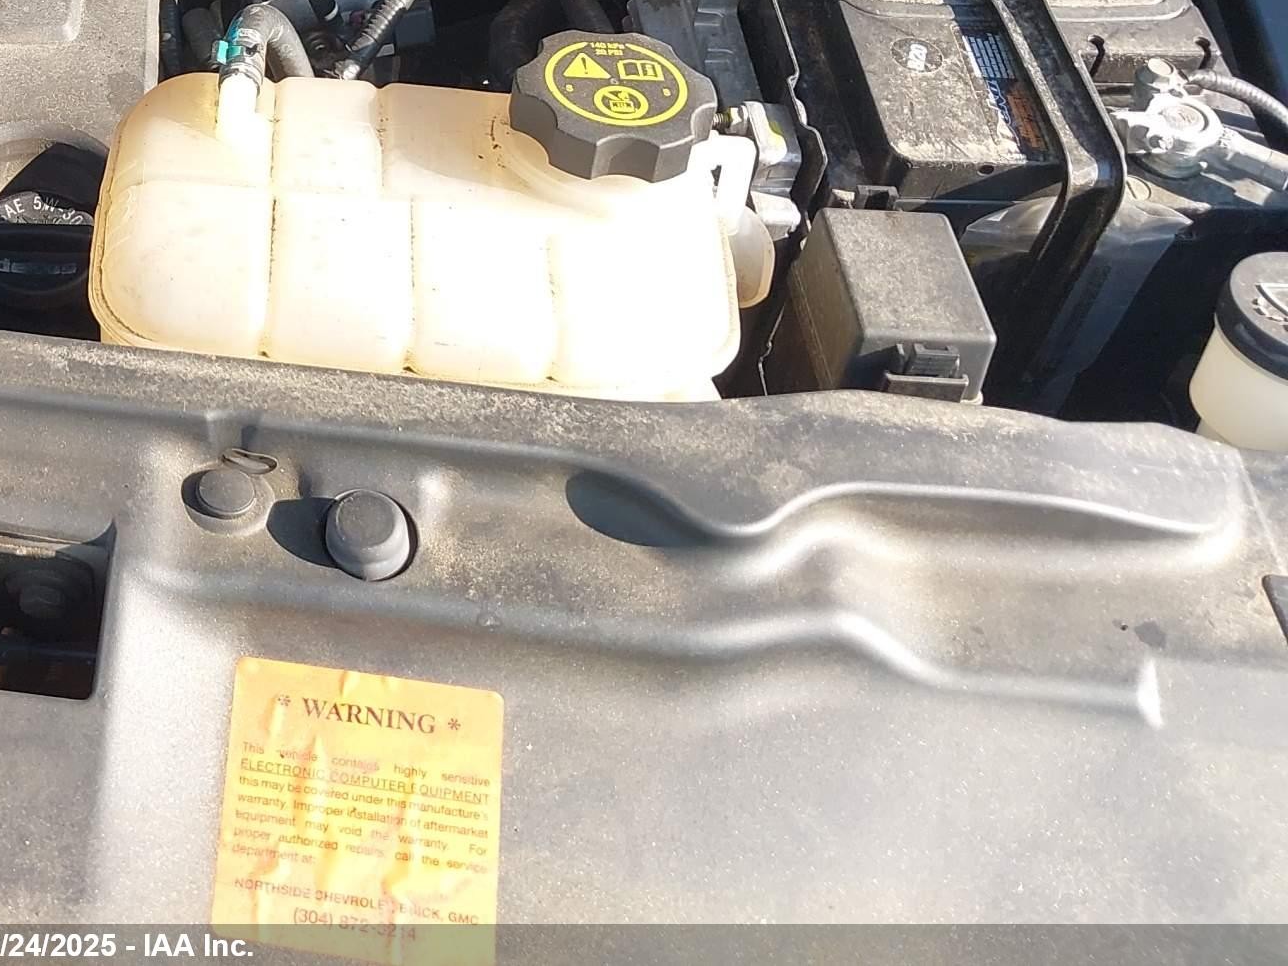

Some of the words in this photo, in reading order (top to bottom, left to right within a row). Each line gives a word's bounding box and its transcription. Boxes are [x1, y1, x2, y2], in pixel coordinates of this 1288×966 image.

[302, 697, 436, 734] WARNING
[240, 757, 325, 779] ELECTRONIC
[329, 769, 405, 791] COMPUTER
[408, 781, 489, 803] EQUIPMENT
[242, 740, 265, 754] This
[394, 763, 427, 779] highly
[441, 772, 491, 787] sensitive
[239, 775, 258, 787] this
[261, 779, 285, 793] may
[287, 780, 302, 793] be
[303, 785, 349, 800] covered
[352, 792, 383, 805] under
[386, 797, 407, 809] this
[233, 826, 272, 841] proper
[278, 834, 338, 851] authorized
[421, 855, 440, 866] the
[305, 819, 330, 833] may
[338, 824, 363, 837] void
[370, 828, 389, 841] the
[468, 843, 488, 856] For
[409, 819, 421, 828] of
[423, 820, 489, 839] aftermarket
[231, 842, 299, 860] department
[234, 878, 312, 899] NORTHSIDE
[447, 911, 480, 926] GMC
[293, 907, 334, 931] (304)
